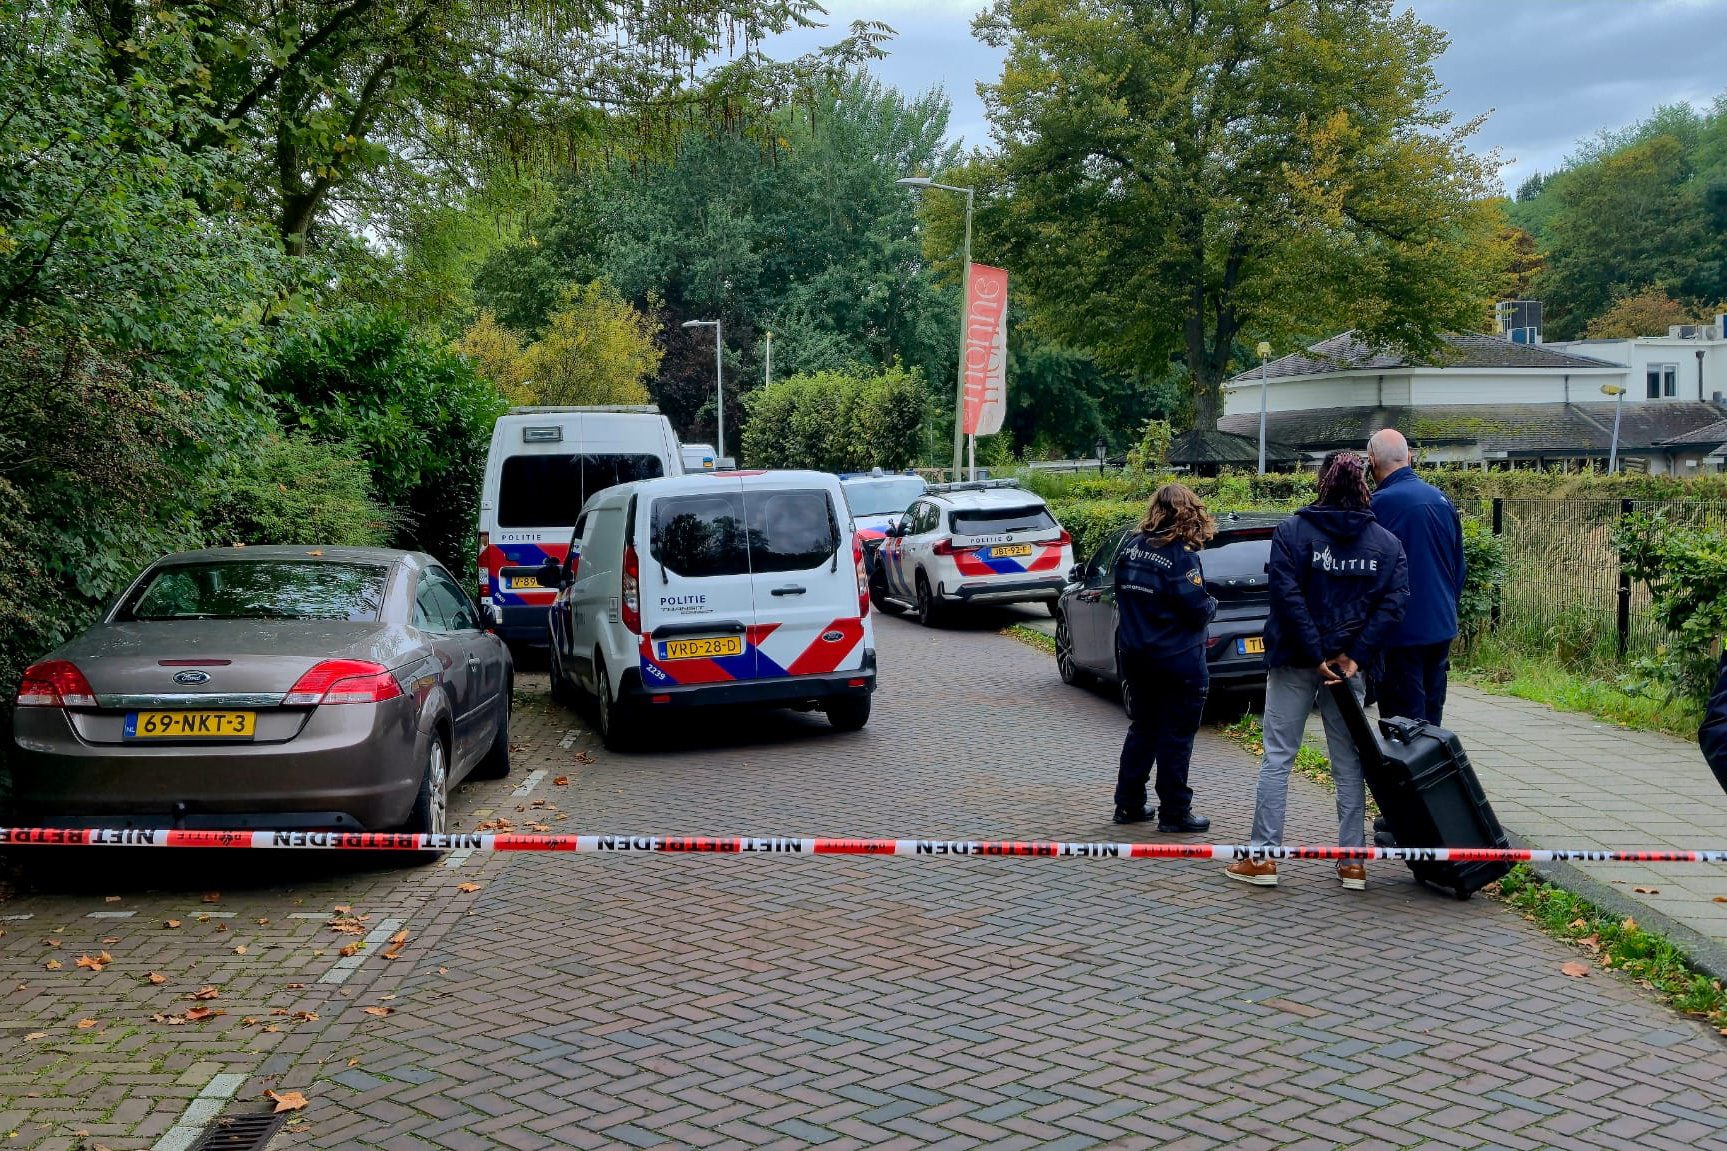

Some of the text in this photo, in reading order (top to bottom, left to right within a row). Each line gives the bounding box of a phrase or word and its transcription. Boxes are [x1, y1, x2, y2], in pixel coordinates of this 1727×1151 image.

[1312, 545, 1378, 572] POLITIE
[514, 577, 536, 586] V-89
[660, 595, 706, 606] POLITIE
[669, 640, 736, 656] VRD-28-D
[646, 664, 666, 681] 2239
[144, 714, 246, 733] 69-NKT-3
[92, 829, 154, 844] NIET
[421, 835, 482, 849] NIET
[742, 839, 802, 852] NIET
[1060, 843, 1119, 856] NIET
